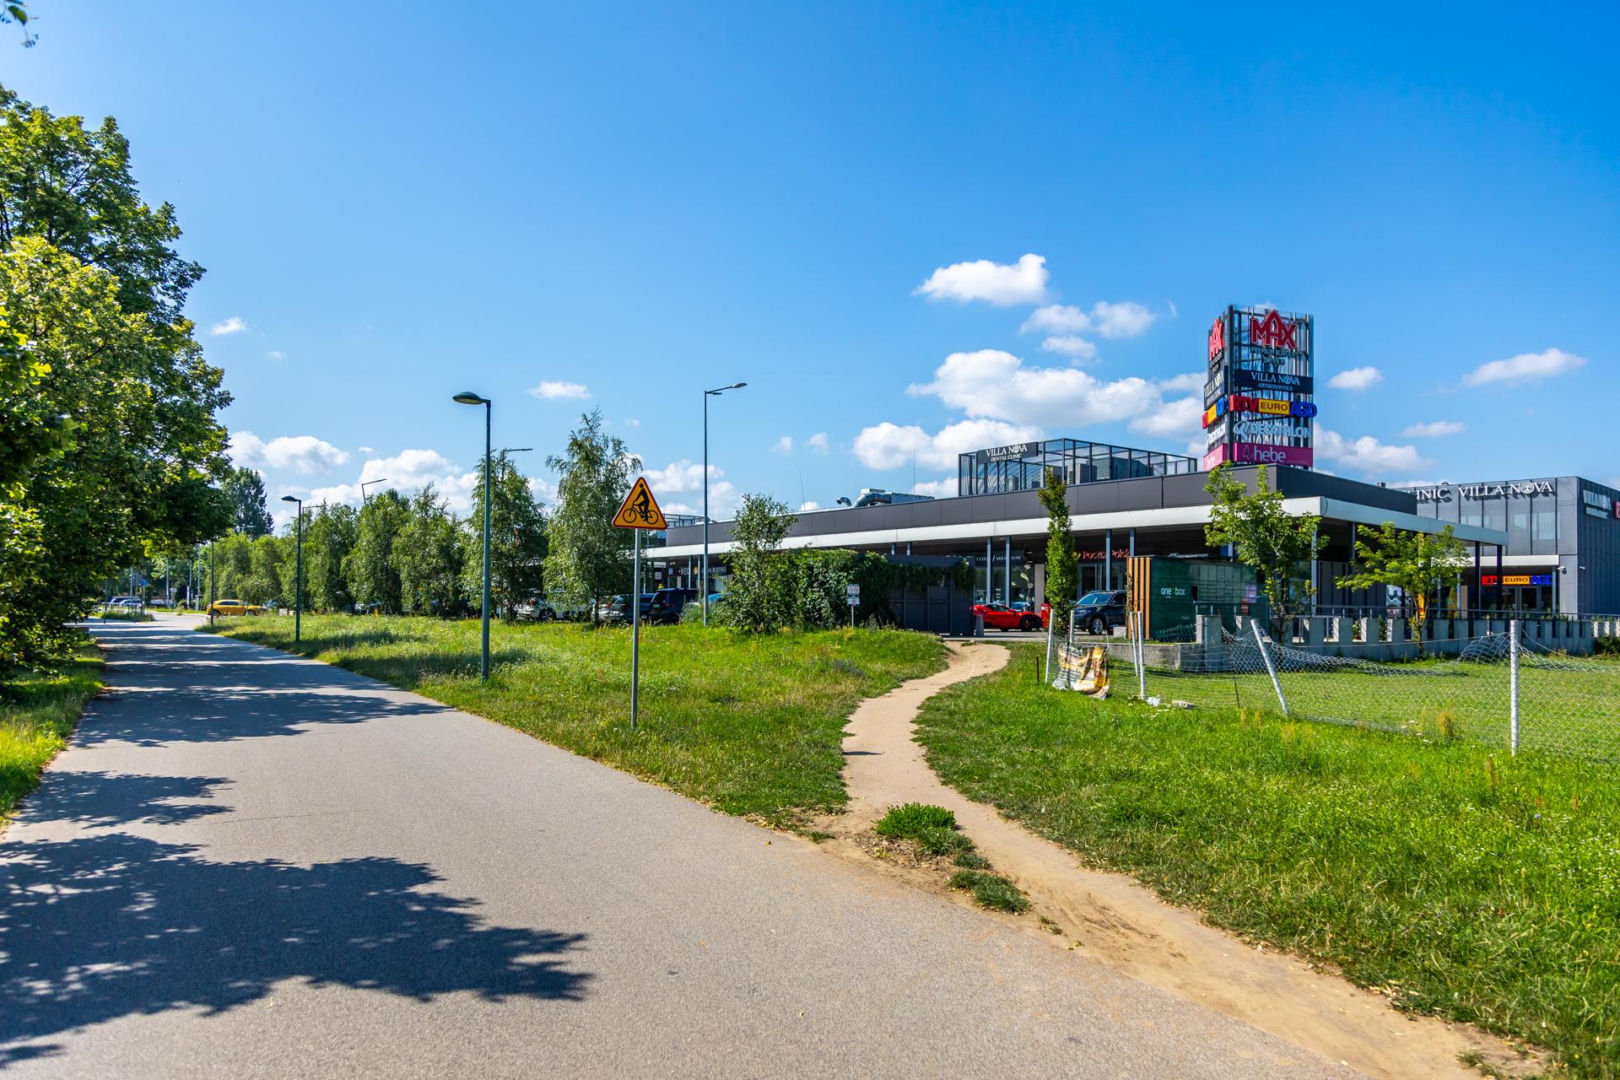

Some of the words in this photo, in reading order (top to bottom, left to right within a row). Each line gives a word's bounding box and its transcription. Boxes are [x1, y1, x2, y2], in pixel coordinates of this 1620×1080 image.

[1251, 309, 1298, 349] MAX
[1251, 371, 1277, 384] VILLA
[1278, 374, 1300, 386] NOVA
[1230, 394, 1259, 413] RTV
[1260, 401, 1288, 412] EURO
[1289, 401, 1317, 418] AGD
[1250, 421, 1312, 439] DECATHLON
[985, 447, 1007, 458] VILLA
[1008, 444, 1028, 454] NOVA
[1254, 445, 1286, 463] hebe
[1458, 484, 1505, 498] VILLA
[1510, 481, 1553, 494] NOVA
[1160, 587, 1172, 596] one
[1175, 586, 1185, 596] box
